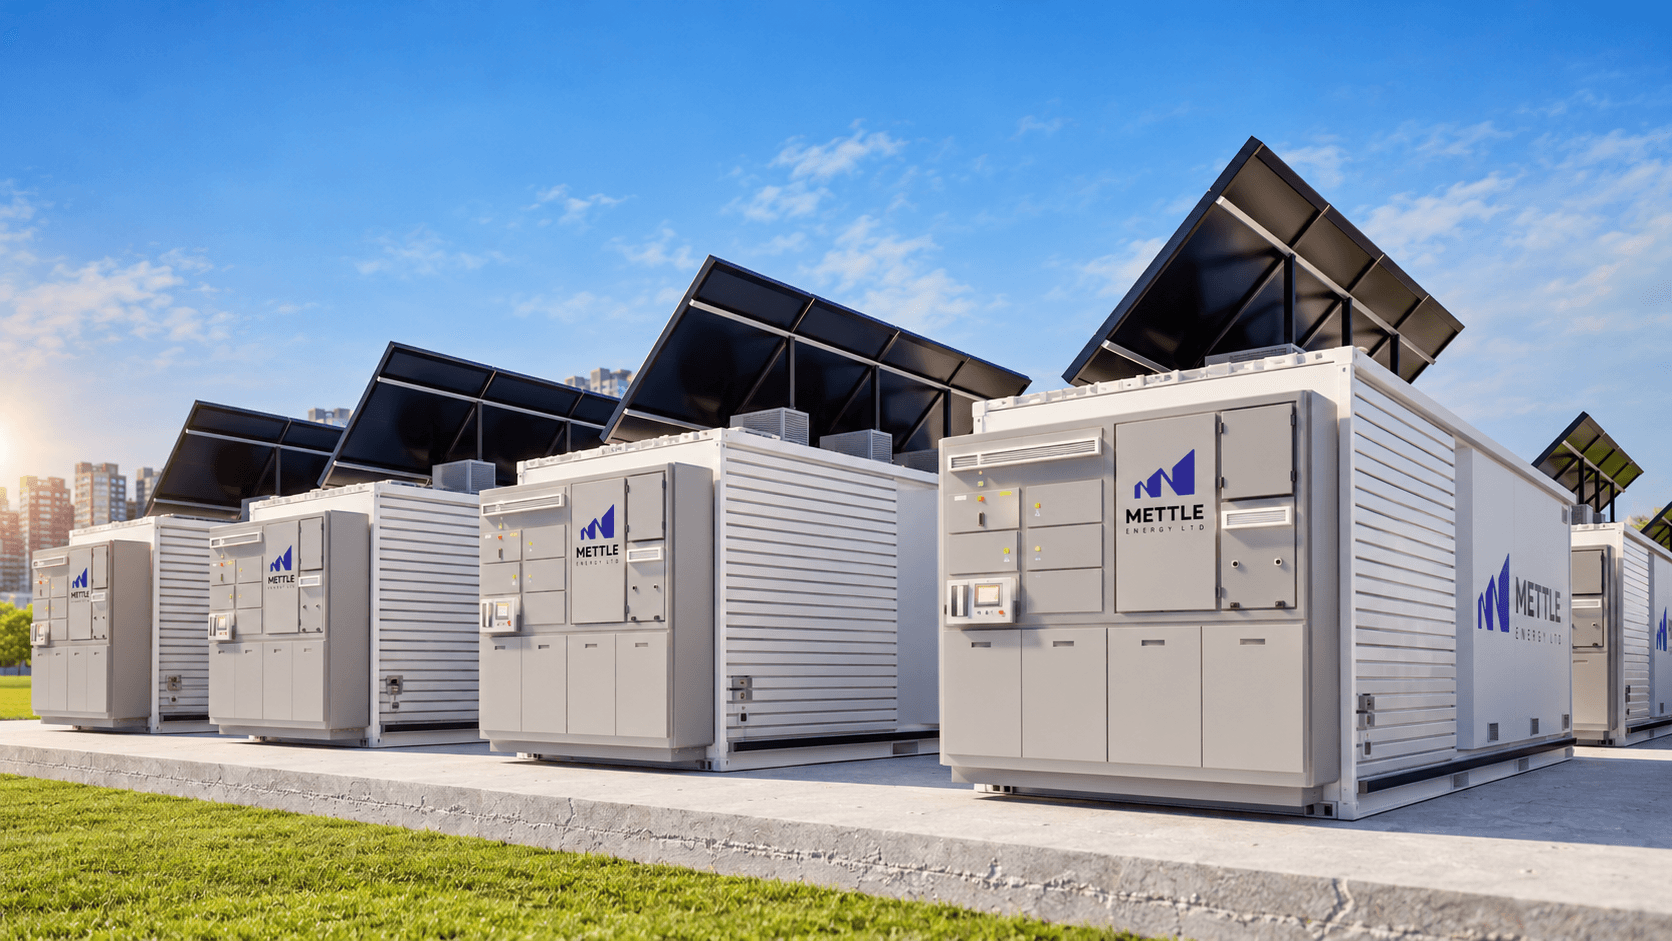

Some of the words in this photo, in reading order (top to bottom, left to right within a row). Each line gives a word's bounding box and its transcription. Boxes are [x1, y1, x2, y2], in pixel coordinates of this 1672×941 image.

[1126, 504, 1204, 524] METTLE
[1125, 526, 1172, 535] ENERGY
[576, 544, 619, 558] METTLE
[267, 574, 295, 584] METTLE
[1515, 576, 1561, 623] METTLE
